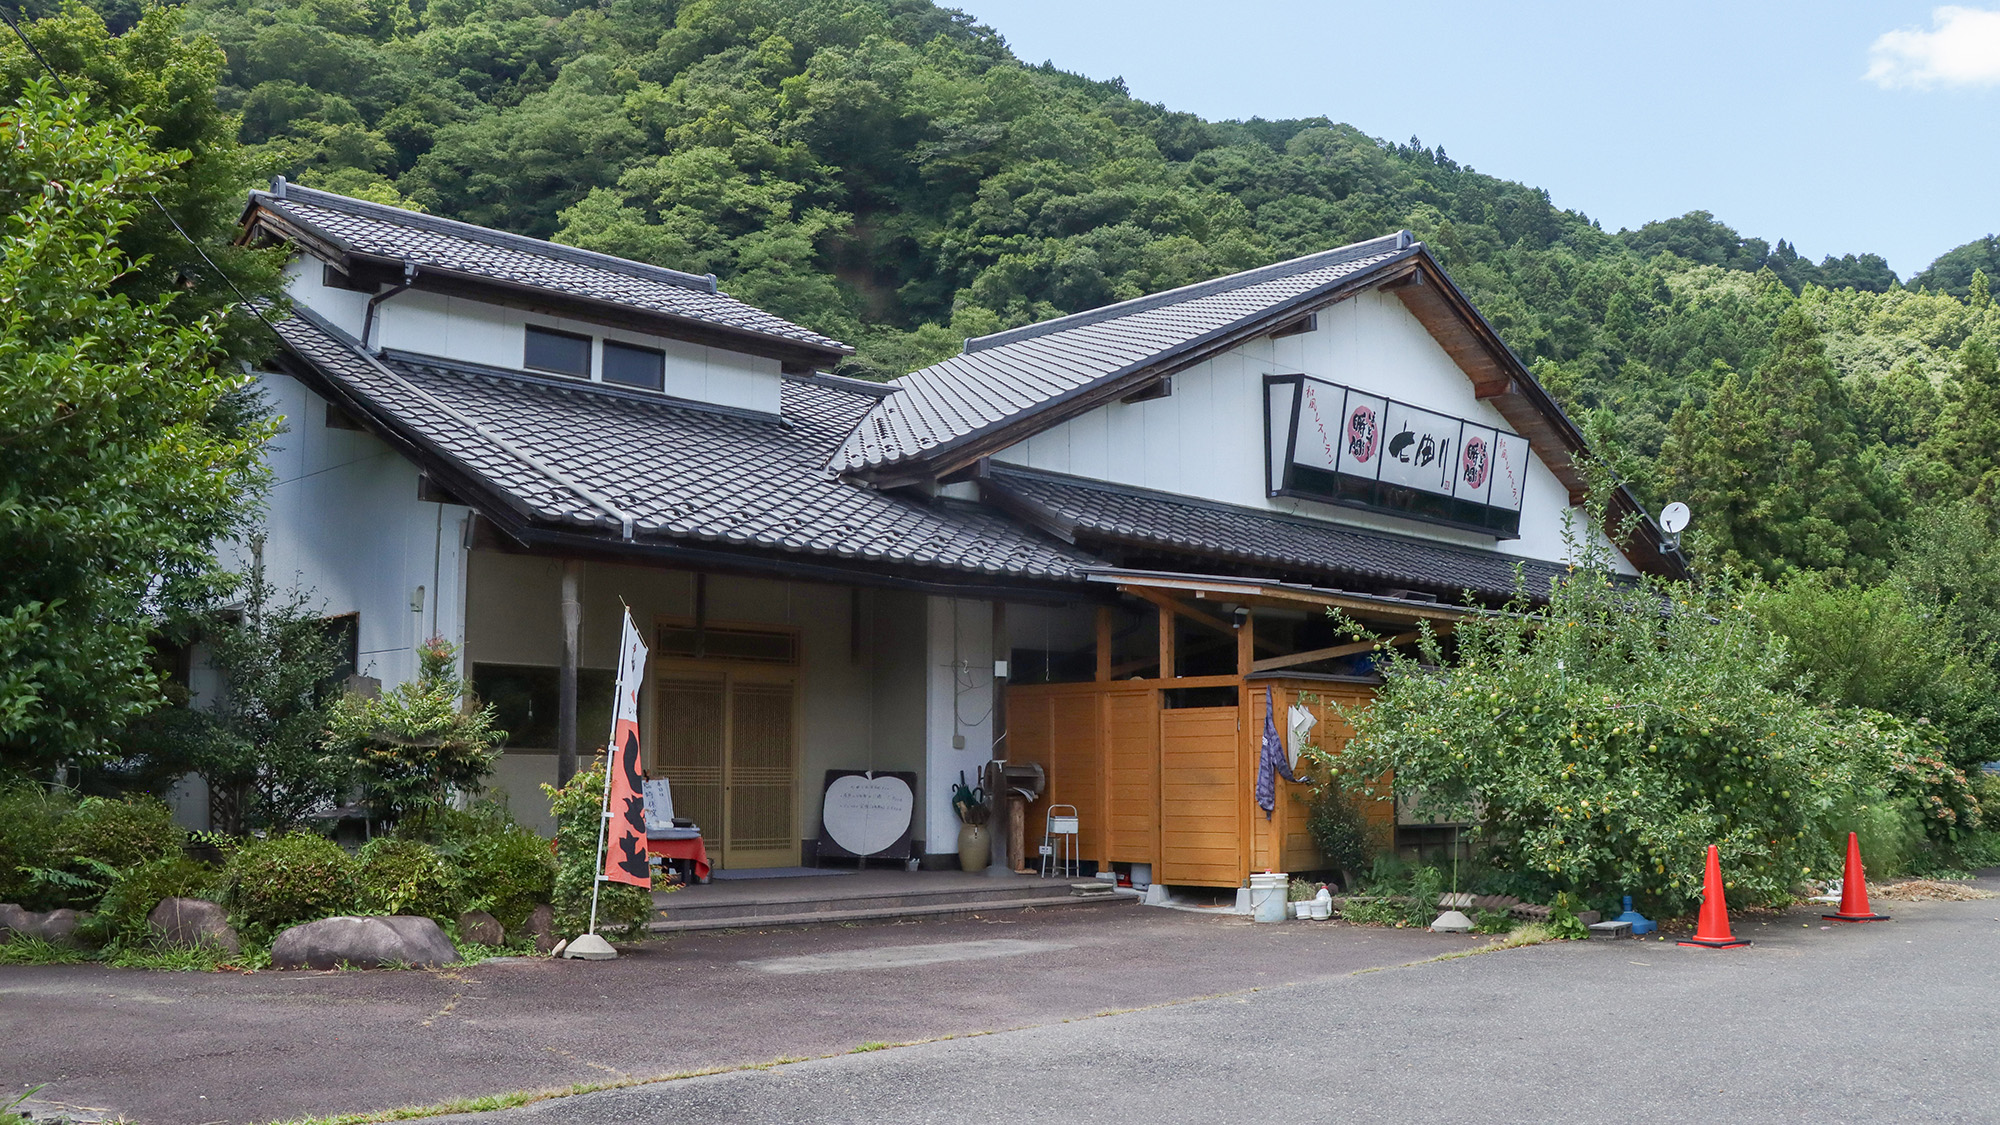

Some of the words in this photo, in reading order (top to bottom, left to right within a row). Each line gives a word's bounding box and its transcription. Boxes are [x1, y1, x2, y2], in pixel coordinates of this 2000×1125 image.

[1305, 384, 1333, 464] 和風レストラン
[1500, 438, 1518, 506] 和風レストラン
